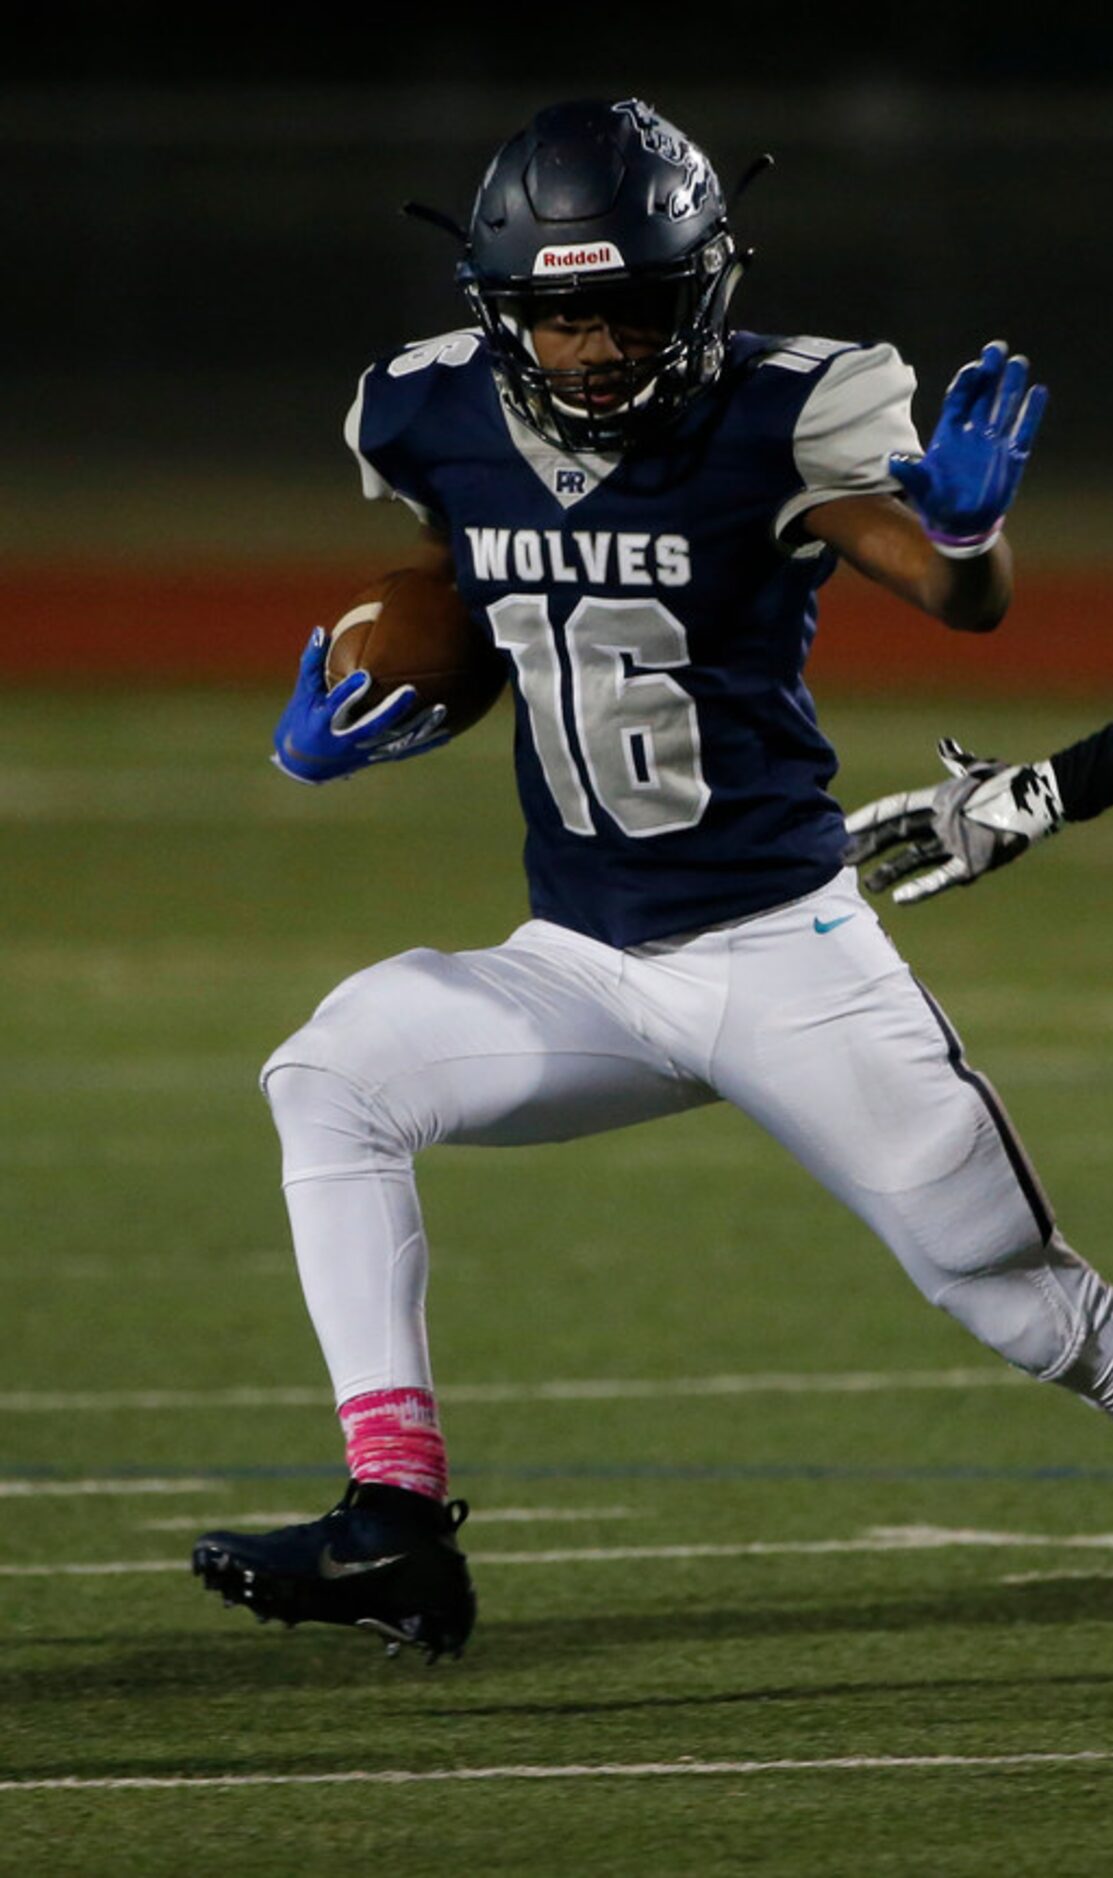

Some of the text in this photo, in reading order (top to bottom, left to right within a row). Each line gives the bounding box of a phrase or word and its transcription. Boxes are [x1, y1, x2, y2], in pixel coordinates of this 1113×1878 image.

[542, 247, 611, 267] Riddell
[555, 468, 586, 495] PR
[464, 527, 692, 587] WOLVES
[485, 593, 712, 838] 16
